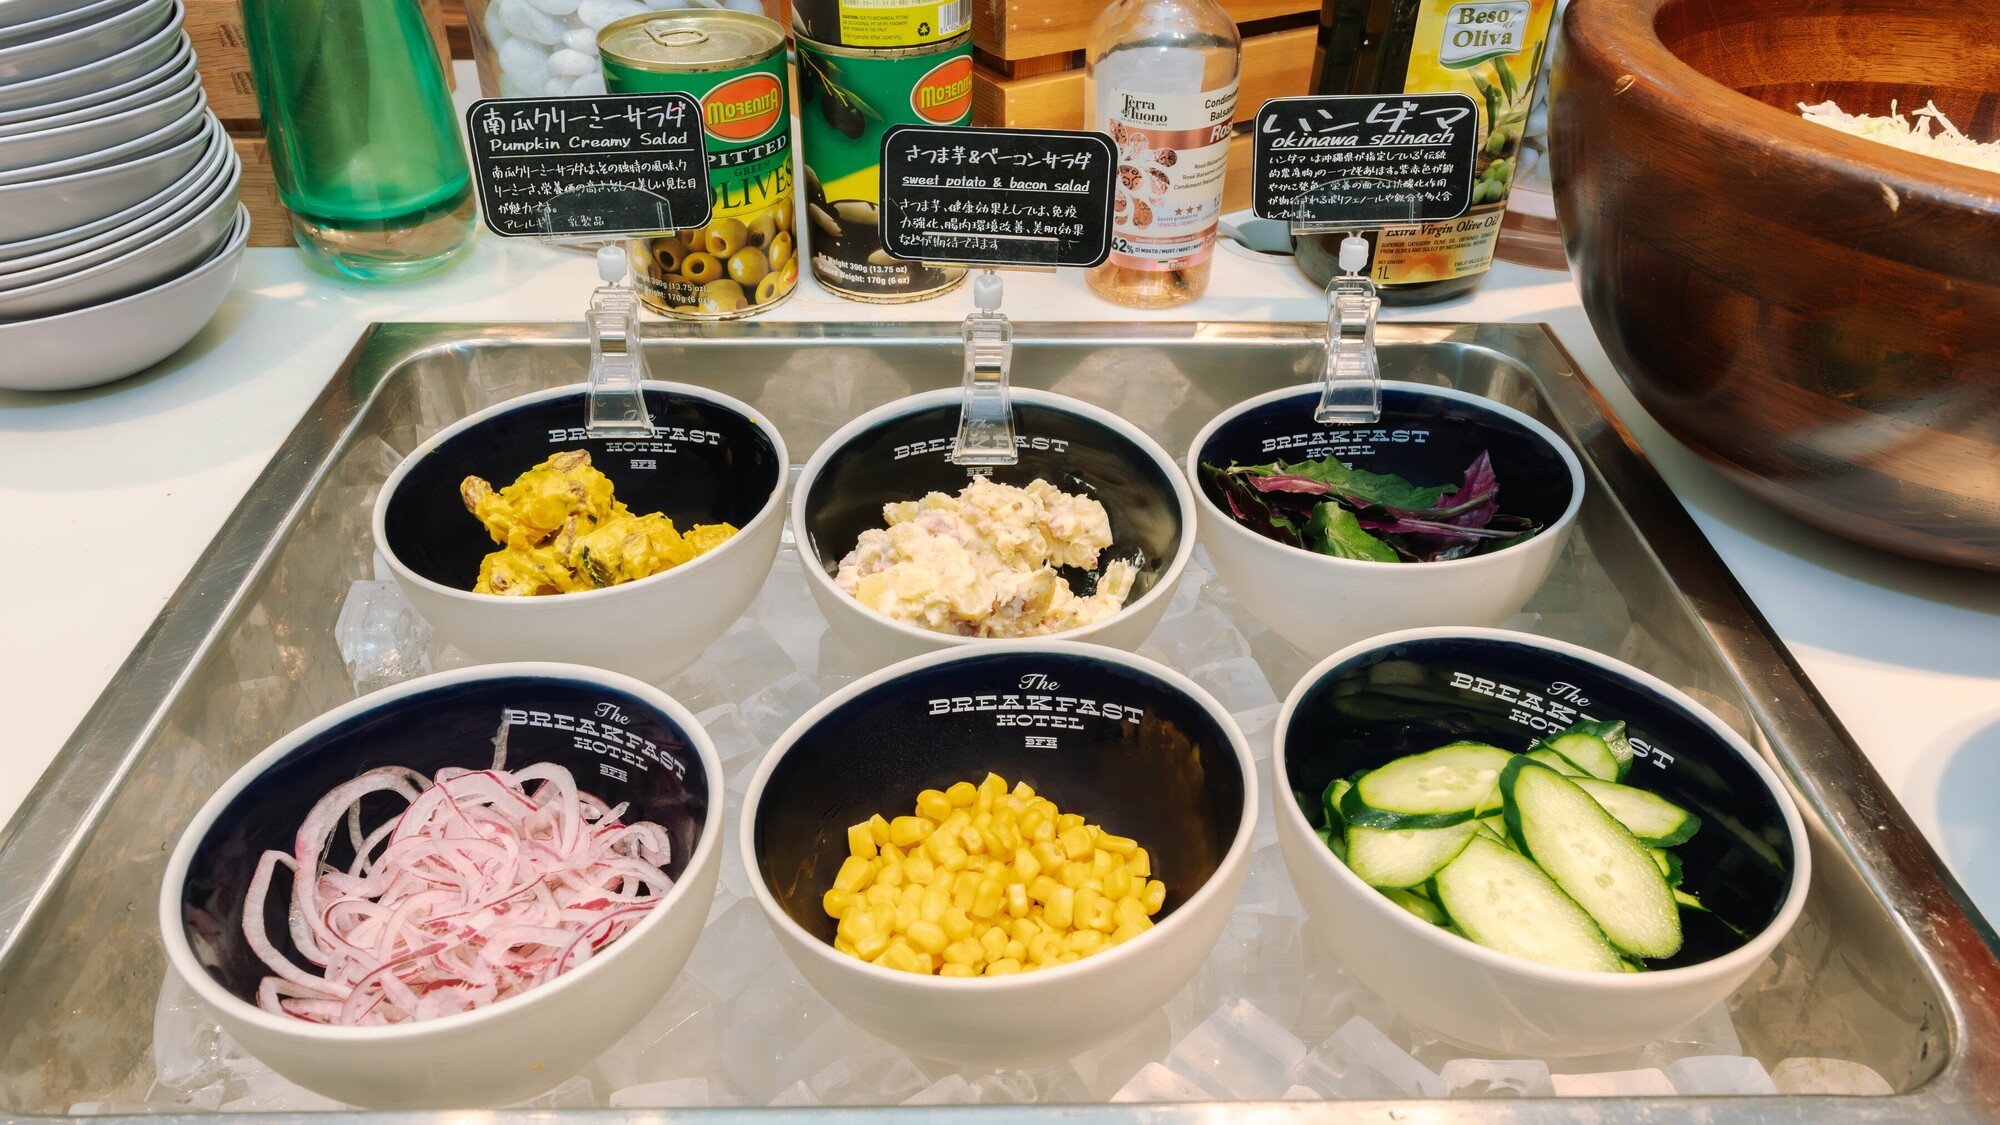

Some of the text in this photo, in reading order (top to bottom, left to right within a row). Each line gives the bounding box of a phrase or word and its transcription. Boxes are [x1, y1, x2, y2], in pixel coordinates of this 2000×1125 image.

[1457, 7, 1510, 25] Beso
[1453, 29, 1512, 48] Oliva
[707, 88, 779, 125] MORENITA
[1121, 93, 1155, 114] Terra
[482, 101, 686, 135] 南瓜クリーミーサラダ
[1262, 101, 1470, 134] ハンダマ
[489, 131, 688, 152] Pumpkin Creamy Salad
[1271, 126, 1456, 148] okinawa spinach
[734, 159, 770, 177] GREEN
[905, 144, 1092, 171] さつま芋&ベーコンサラダ
[902, 174, 1090, 192] sweet potato & bacon salad
[1385, 214, 1500, 238] Extra Virgin Olive Oil
[839, 270, 865, 283] Weight:
[867, 276, 886, 285] 170g
[888, 277, 896, 285] (6
[897, 276, 910, 285] oz)
[850, 262, 868, 273] 390g
[869, 265, 894, 274] (13.75
[895, 266, 908, 274] oz)
[1378, 265, 1390, 280] 1L
[669, 282, 692, 292] (13.75
[668, 293, 686, 304] 170g
[605, 442, 677, 454] HOTEL
[1261, 429, 1430, 453] BREAKFAST
[1018, 673, 1061, 691] The
[1546, 681, 1592, 708] The
[594, 702, 631, 726] The
[928, 694, 1144, 725] BREAKFAST
[996, 714, 1085, 730] HOTEL
[1450, 671, 1675, 770] BREAKST
[505, 708, 686, 782] BREAKFAST
[573, 736, 649, 772] HOTEL
